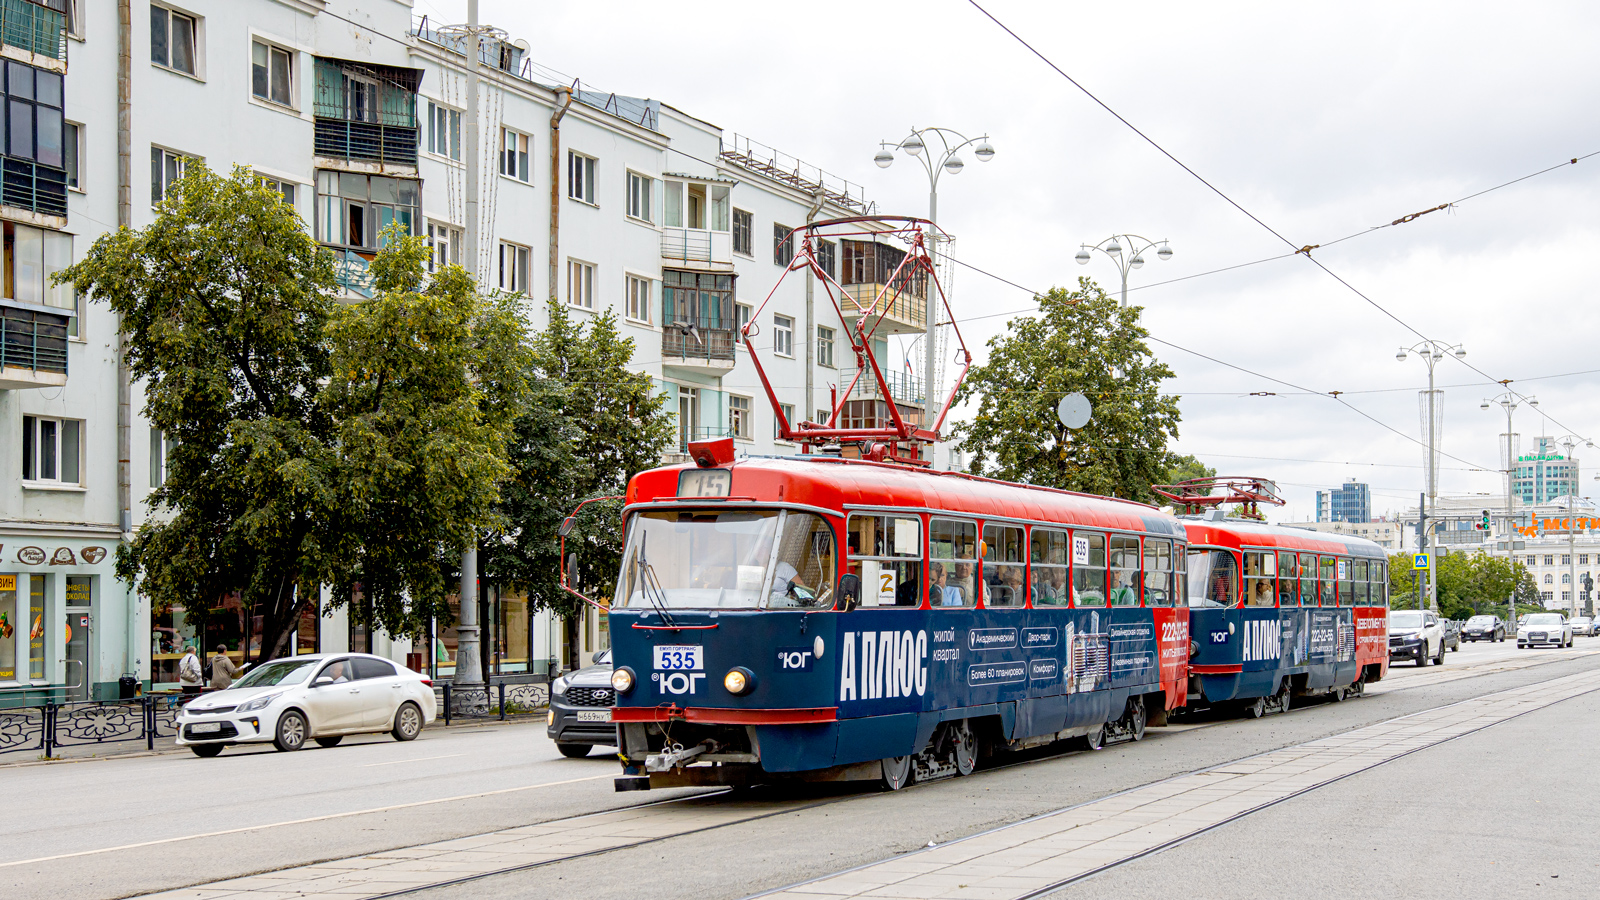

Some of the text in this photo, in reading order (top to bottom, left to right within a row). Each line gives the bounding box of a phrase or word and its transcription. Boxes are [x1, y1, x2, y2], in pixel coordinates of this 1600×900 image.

[696, 475, 724, 497] 15
[1076, 540, 1086, 556] 535
[880, 574, 894, 593] Z
[66, 592, 90, 600] ОКОЛАД
[933, 626, 955, 642] жилой
[976, 632, 1015, 644] Академический
[1028, 632, 1051, 643] Двор-парк
[1252, 619, 1280, 660] ПЛЮС
[1311, 629, 1333, 642] 222-22-55
[661, 652, 695, 669] 535
[861, 629, 927, 698] ПЛЮС
[933, 648, 960, 664] квартал
[971, 667, 1024, 680] Более 60 планировок
